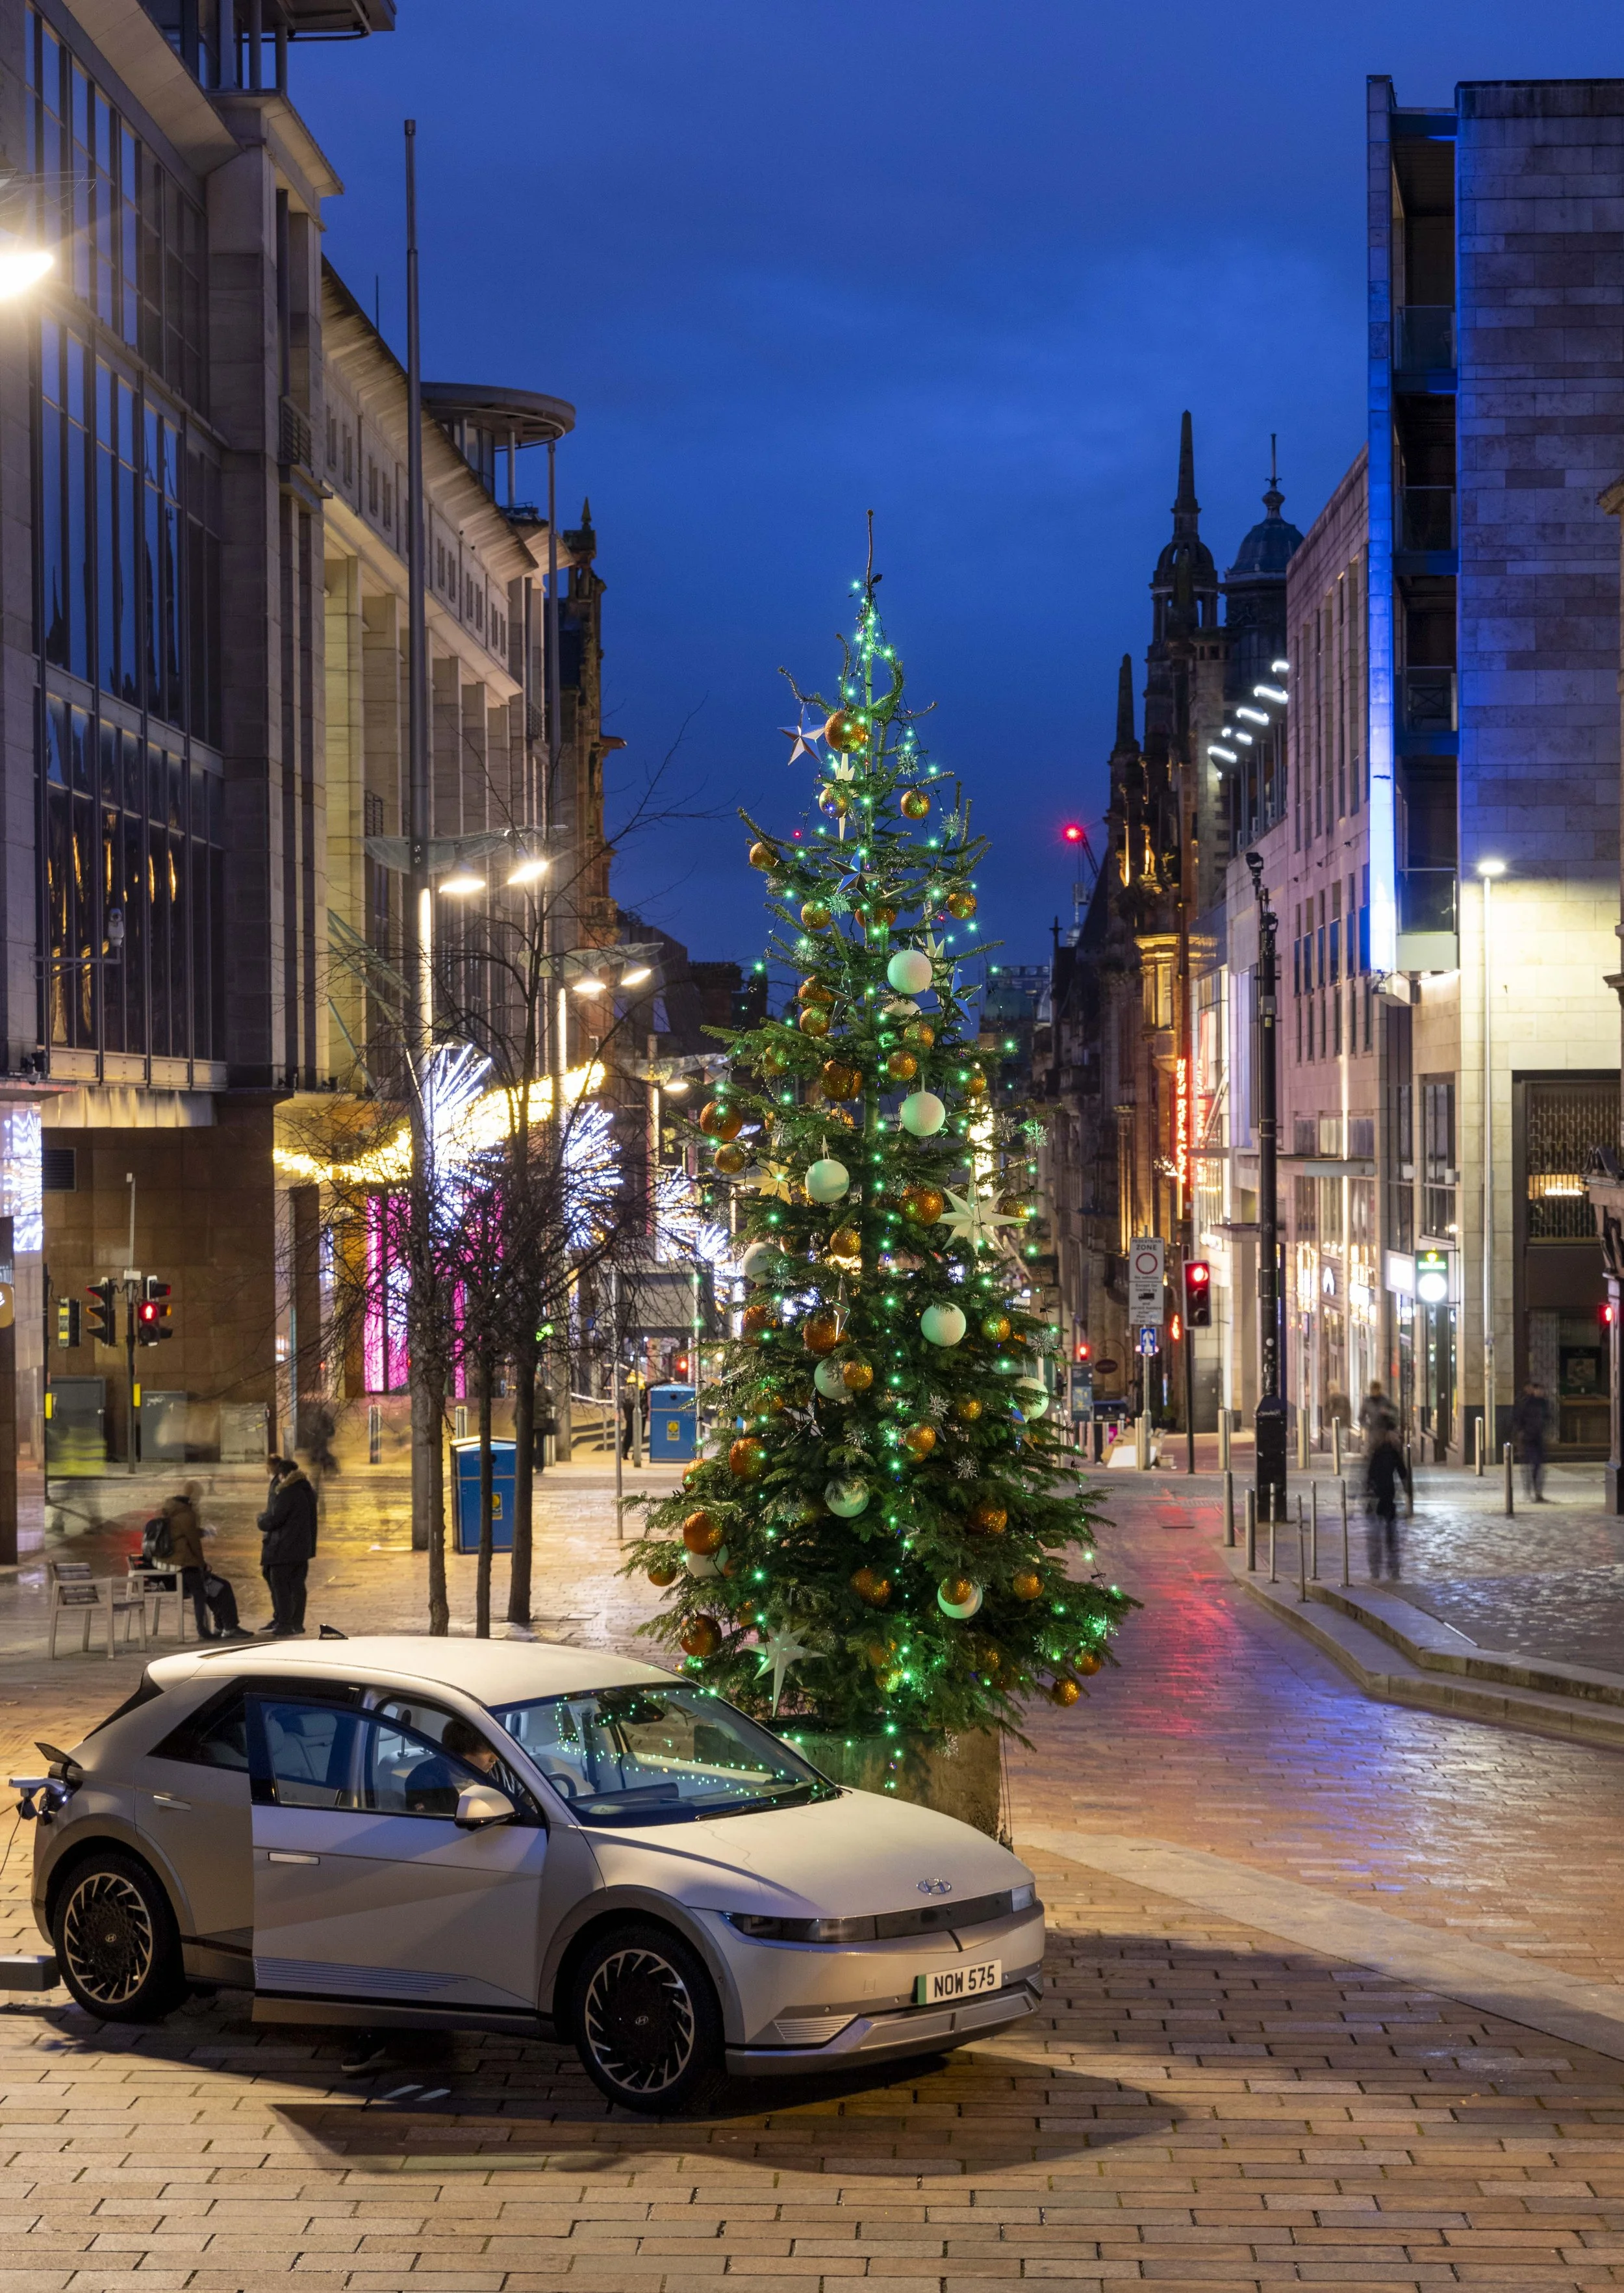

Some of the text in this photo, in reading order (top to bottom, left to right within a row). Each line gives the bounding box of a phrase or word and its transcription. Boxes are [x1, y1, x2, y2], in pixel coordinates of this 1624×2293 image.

[1176, 1058, 1187, 1095] Hard
[1176, 1099, 1187, 1142] Rock
[934, 1965, 995, 1997] NOW 575
